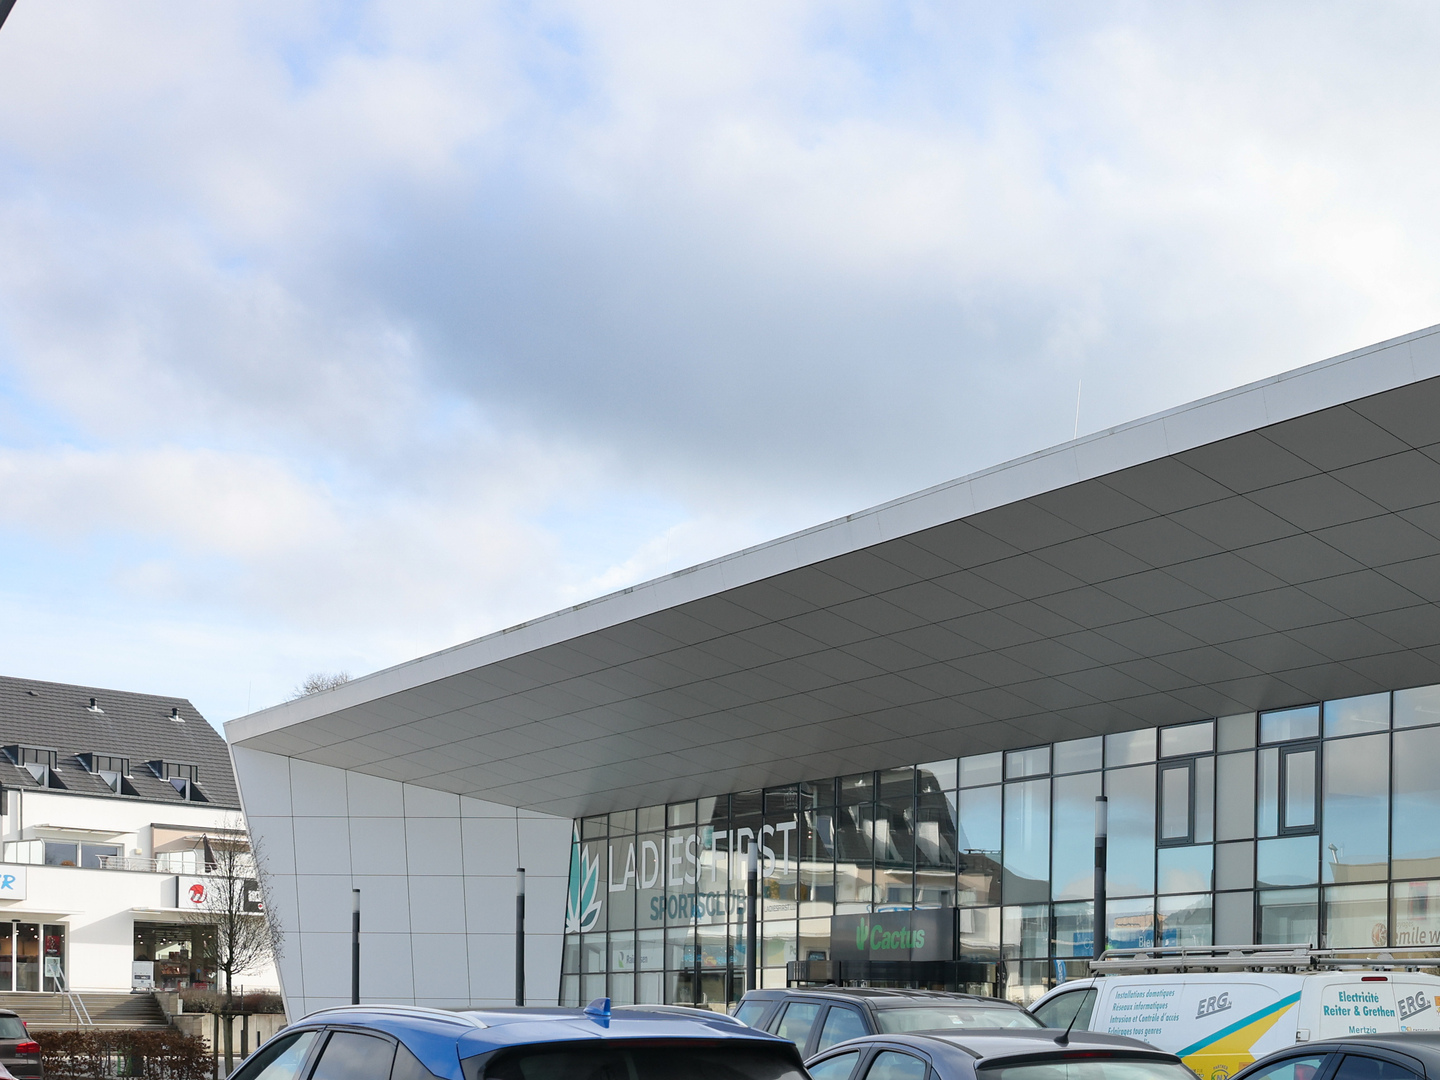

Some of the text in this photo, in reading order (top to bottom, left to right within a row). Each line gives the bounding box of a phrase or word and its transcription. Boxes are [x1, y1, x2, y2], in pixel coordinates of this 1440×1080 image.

[609, 820, 797, 892] LADIES FIRST
[0, 874, 16, 890] R
[650, 889, 746, 921] SPORTSCLUB
[870, 924, 925, 950] Cactus
[1115, 989, 1175, 999] Installations domotiques
[1338, 991, 1379, 1003] Electricité
[1112, 1000, 1168, 1012] Réseaux informatiques
[1197, 992, 1228, 1015] ERG
[1397, 991, 1427, 1017] ERG
[1323, 1005, 1396, 1017] Reiter & Grethen
[1110, 1014, 1131, 1023] Intrusion
[1139, 1013, 1160, 1022] Contrôle
[1133, 1027, 1144, 1035] tous
[1145, 1026, 1162, 1037] genres
[1348, 1025, 1377, 1034] Mertzig
